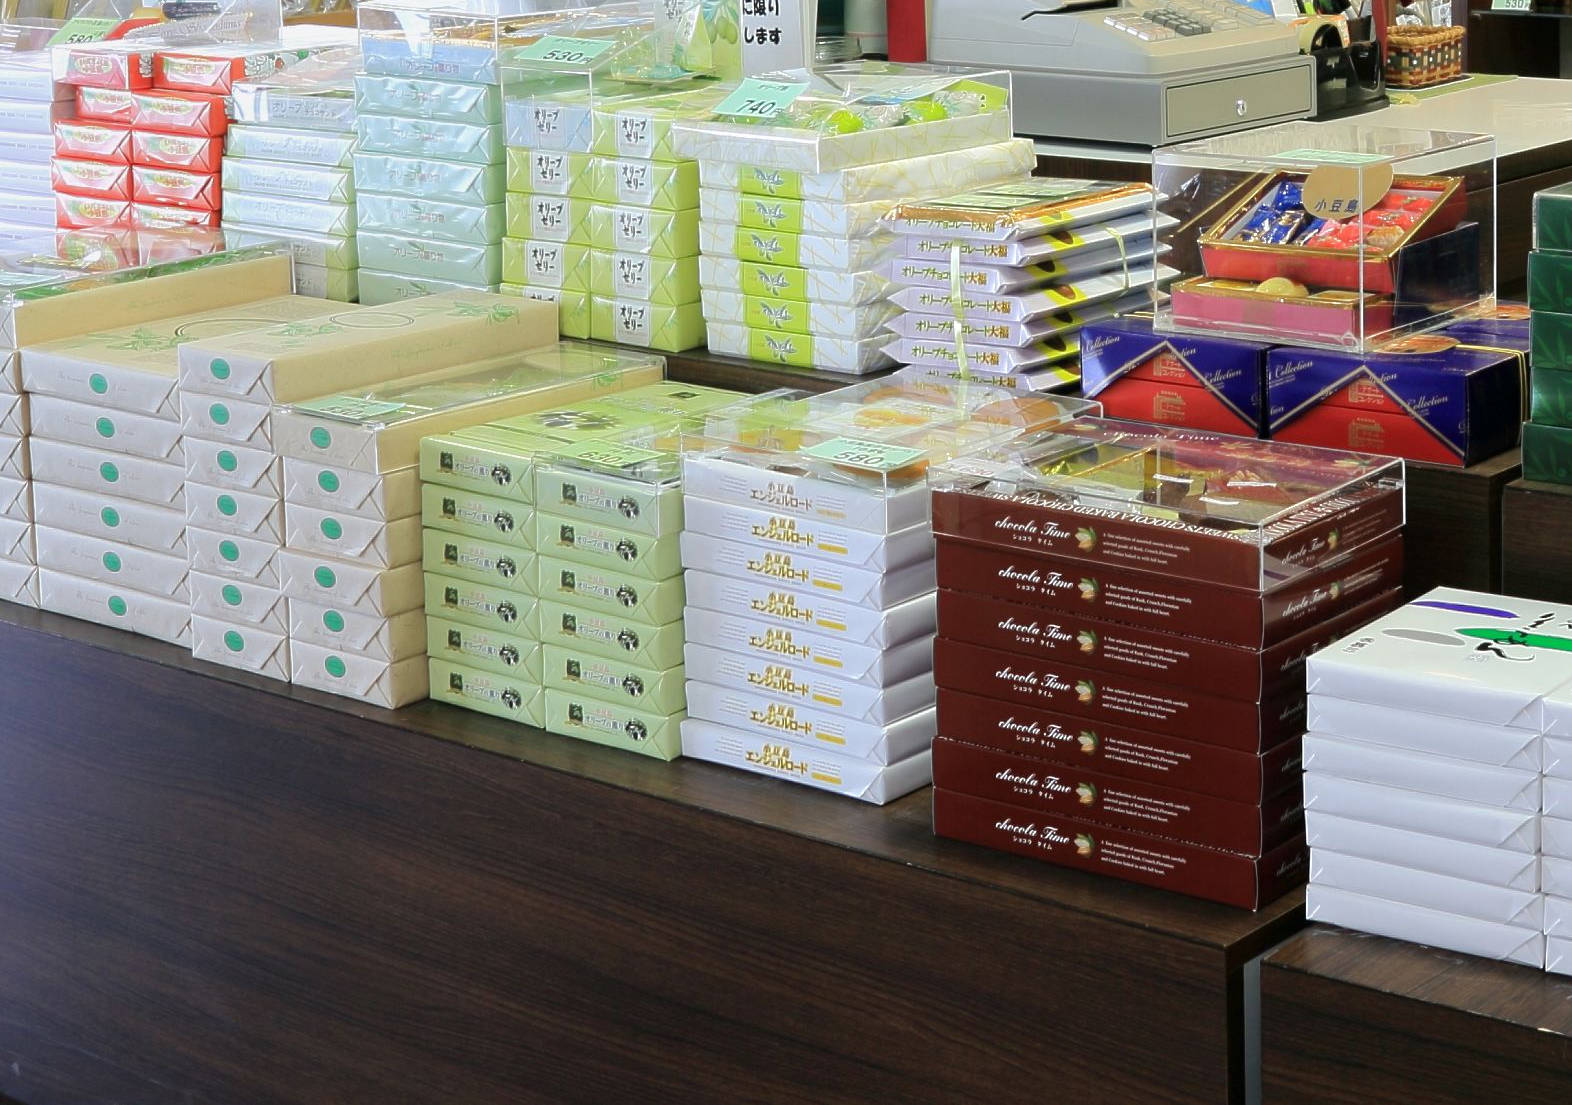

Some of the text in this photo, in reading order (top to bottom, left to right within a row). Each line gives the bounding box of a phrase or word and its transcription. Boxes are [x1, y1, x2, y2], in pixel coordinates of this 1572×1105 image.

[744, 27, 782, 46] します
[534, 109, 560, 122] オリーブ
[537, 120, 557, 133] ゼリー
[622, 118, 647, 131] オリーブ
[625, 130, 645, 143] ゼリー
[537, 156, 563, 169] オリーブ
[540, 167, 561, 181] ゼリー
[622, 165, 647, 178] オリーブ
[625, 177, 645, 191] ゼリー
[537, 202, 563, 216] オリーブ
[1314, 197, 1359, 213] 小豆島
[540, 214, 562, 228] ゼリー
[619, 212, 645, 226] オリーブ
[622, 224, 643, 238] ゼリー
[531, 247, 558, 260] オリーブ
[535, 259, 555, 273] ゼリー
[619, 259, 645, 273] オリーブ
[623, 271, 643, 284] ゼリー
[620, 305, 646, 319] オリーブ
[624, 317, 643, 331] ゼリー
[750, 489, 813, 511] エンジェルロード
[995, 516, 1070, 539] chocola Time
[752, 524, 815, 547] エンジェルロード
[747, 559, 809, 583] エンジェルロード
[998, 566, 1073, 590] chocola Time
[751, 598, 814, 622] エンジェルロード
[998, 617, 1072, 642] chocola Time
[749, 635, 810, 658] エンジェルロード
[747, 673, 809, 696] エンジェルロード
[996, 667, 1070, 691] chocola Time
[750, 709, 812, 734] エンジェルロード
[999, 717, 1073, 742] chocola Time
[745, 750, 808, 775] エンジェルロード
[996, 768, 1071, 793] chocola Time
[996, 818, 1070, 844] chocola Time
